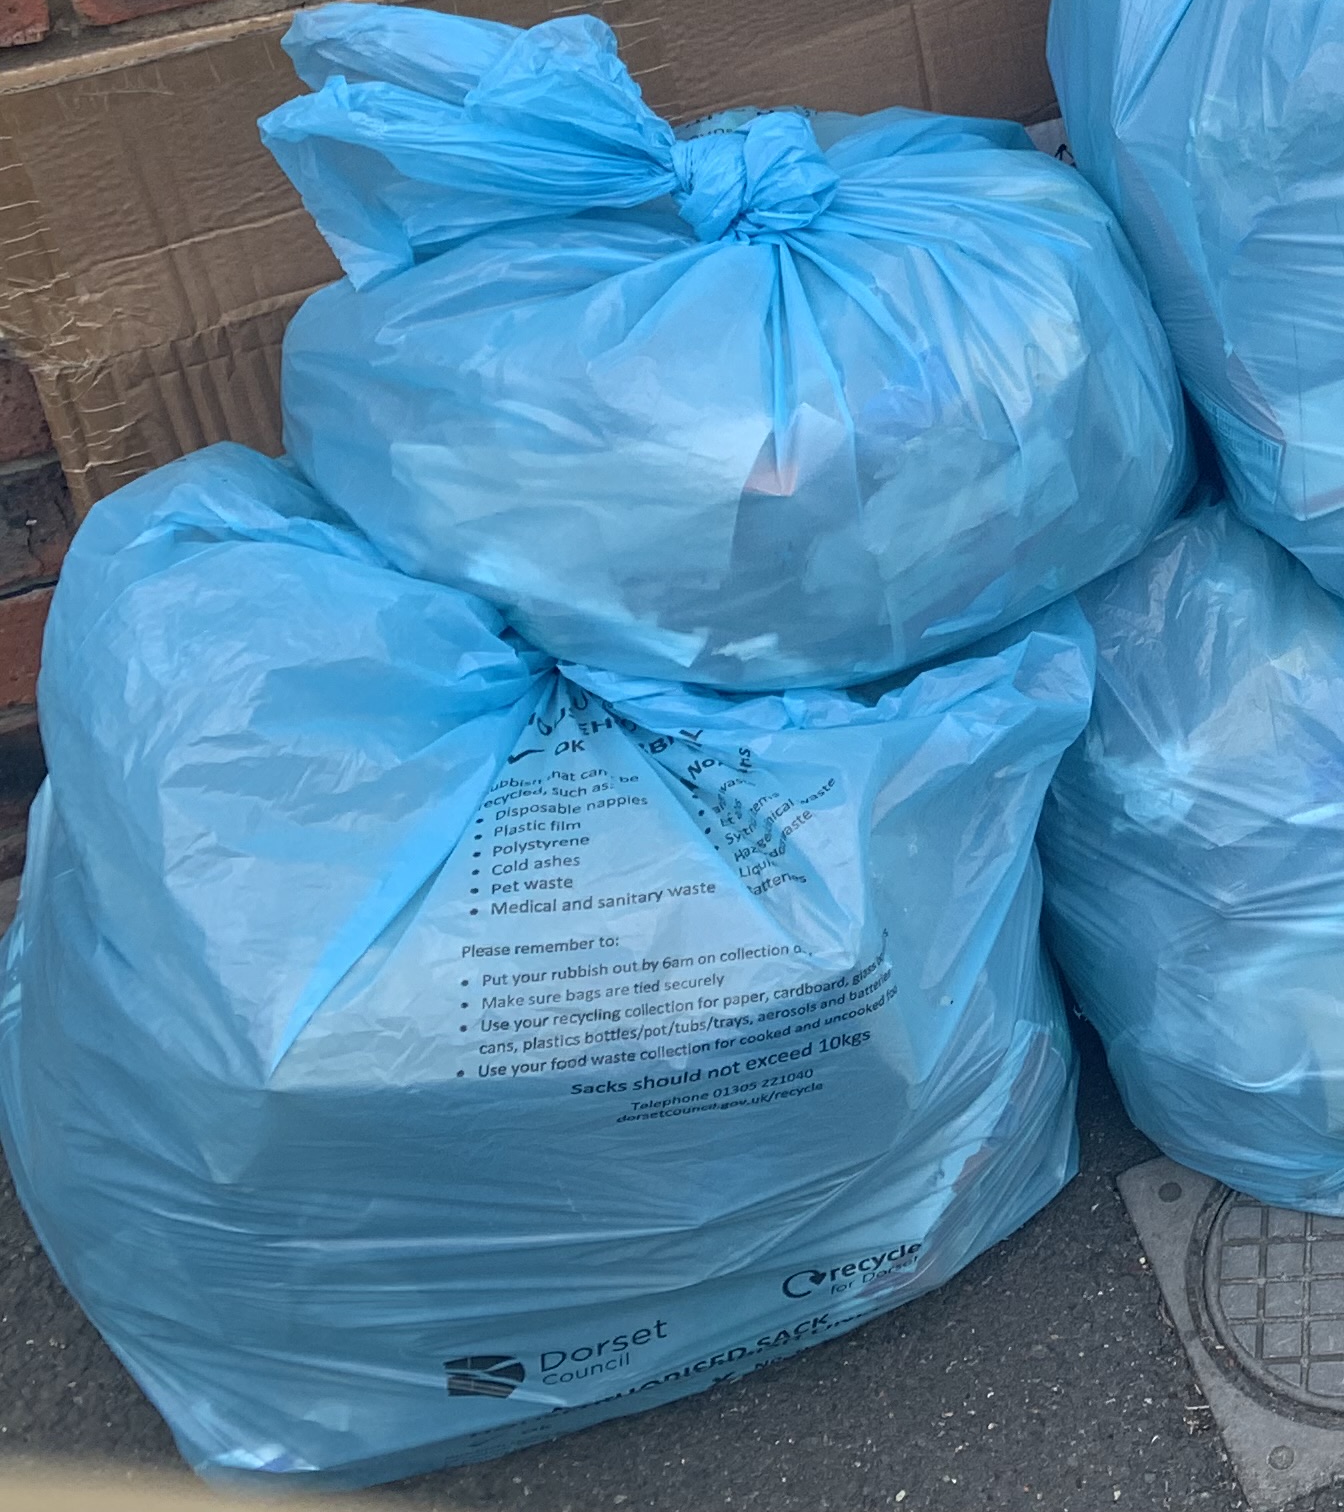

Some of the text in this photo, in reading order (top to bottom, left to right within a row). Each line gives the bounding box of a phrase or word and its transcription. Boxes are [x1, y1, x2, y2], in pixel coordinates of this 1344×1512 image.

[494, 820, 581, 837] Plastic film
[492, 835, 590, 857] Polystyrene
[491, 855, 581, 876] Cold ashes
[491, 877, 573, 895] Pet waste
[462, 936, 620, 958] Please remember to:
[482, 944, 789, 987] Put your rubbish out by 6am on collection
[570, 1029, 871, 1095] Sacks should not exceed 10kgs
[830, 1241, 922, 1282] recycle
[539, 1318, 669, 1372] Dorset
[543, 1352, 631, 1386] Council
